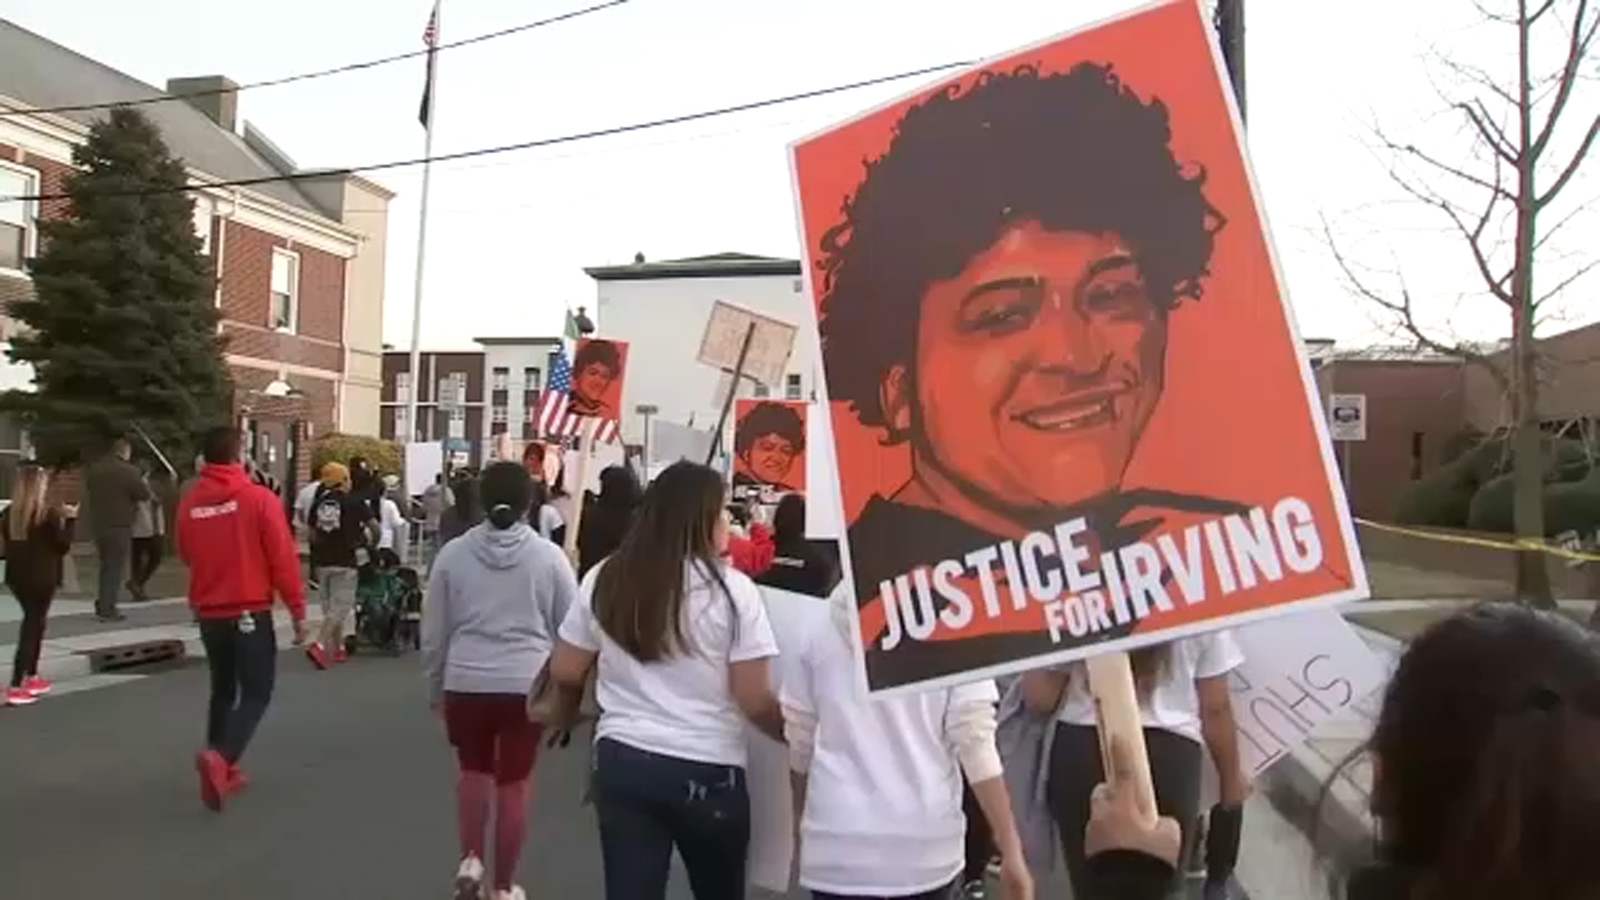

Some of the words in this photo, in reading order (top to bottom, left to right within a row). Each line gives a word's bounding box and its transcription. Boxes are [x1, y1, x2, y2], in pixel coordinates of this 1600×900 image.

[880, 518, 1100, 650] JUSTICE
[1046, 591, 1112, 642] FOR
[1102, 497, 1322, 622] IRVING
[1236, 654, 1352, 771] SHUT
